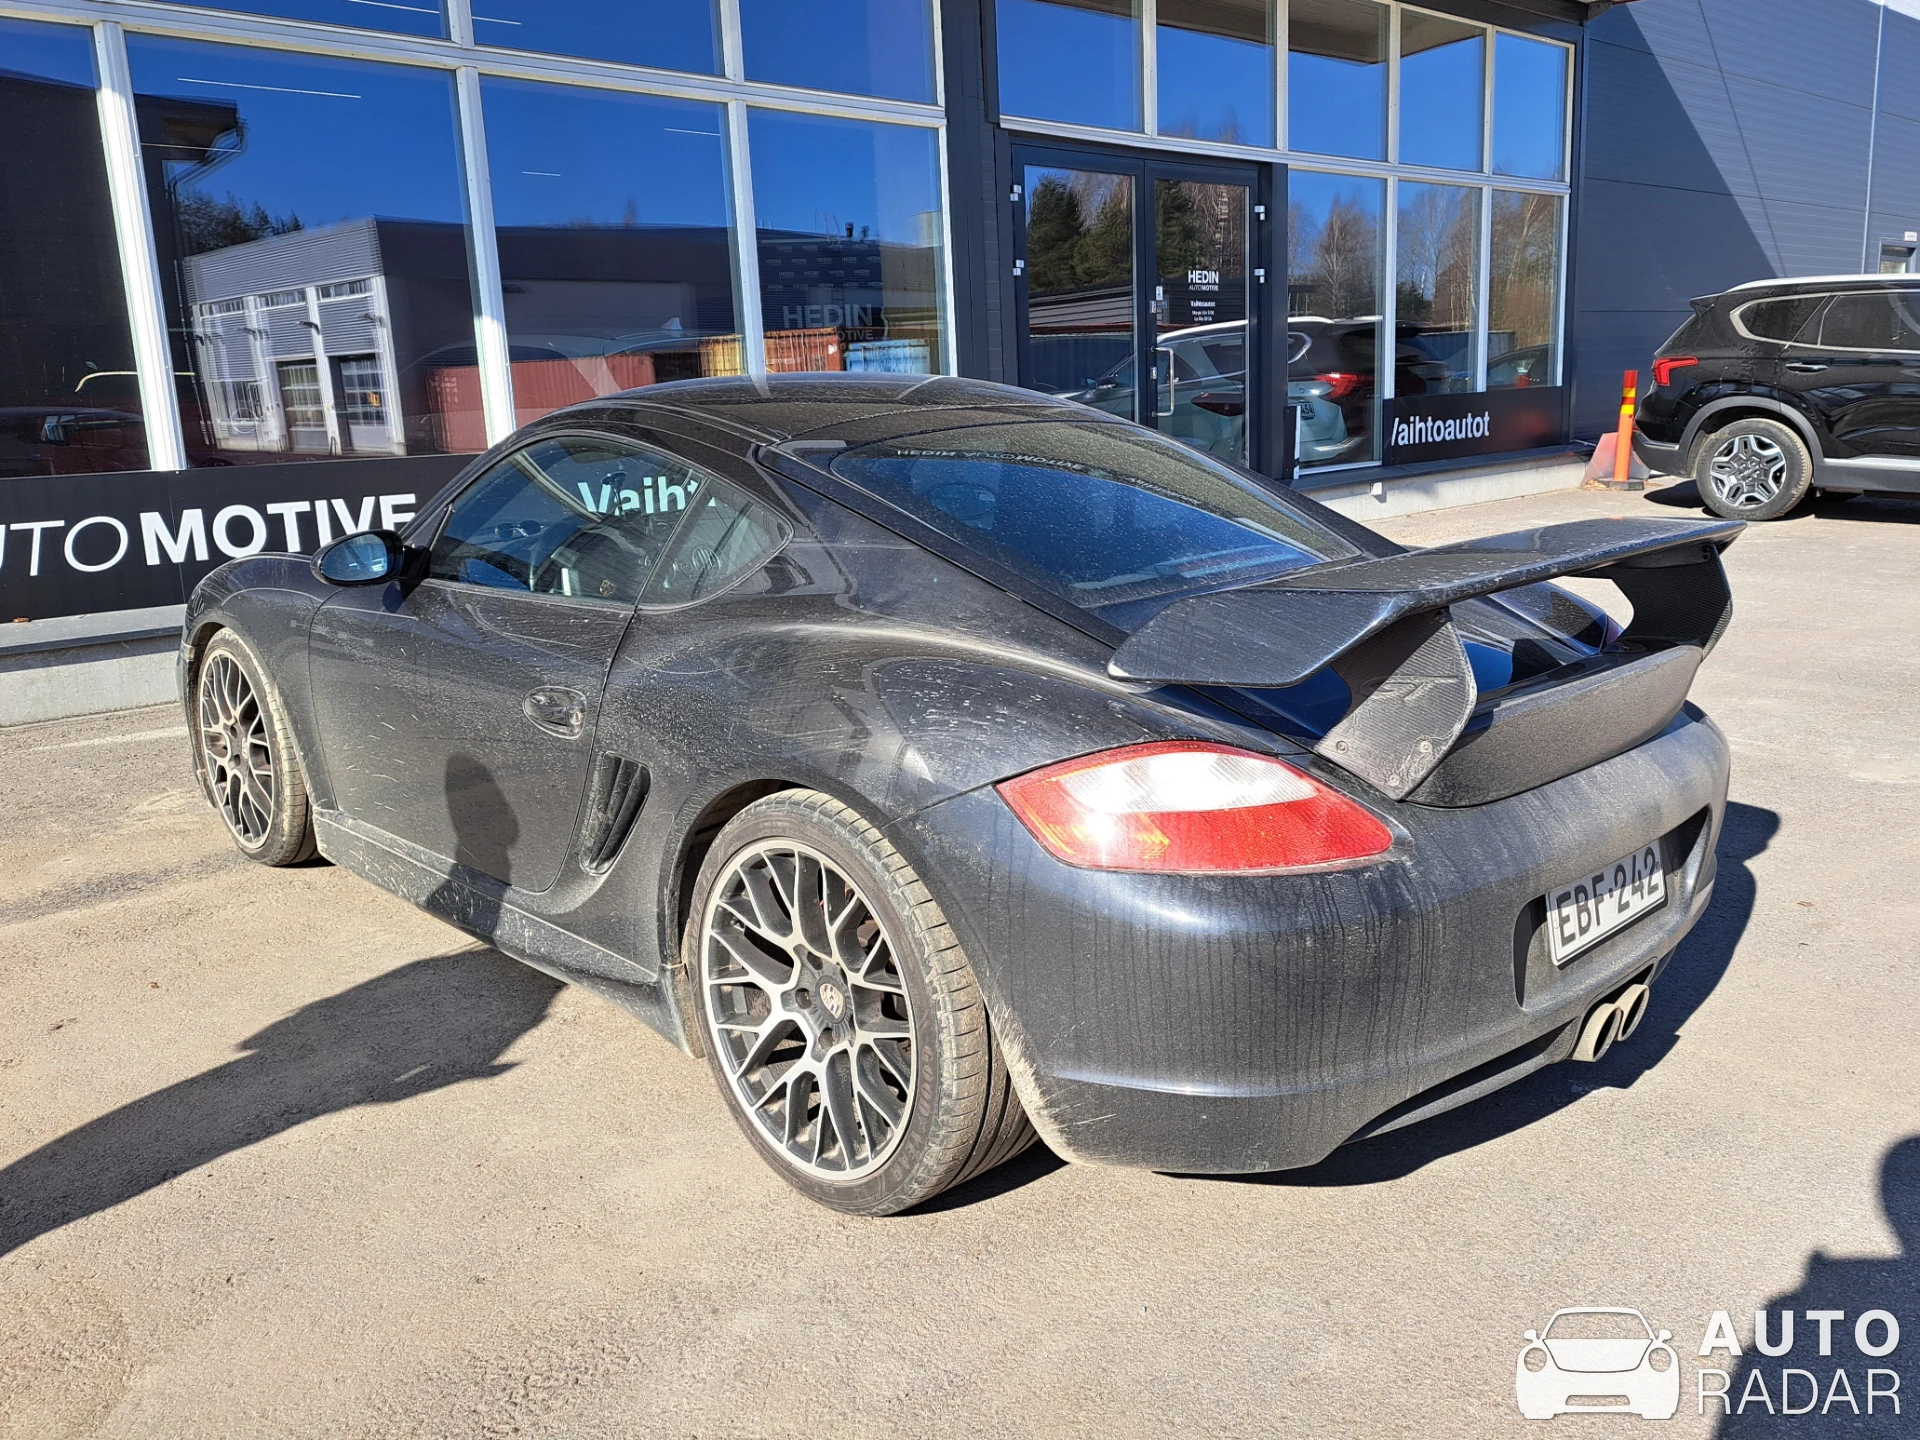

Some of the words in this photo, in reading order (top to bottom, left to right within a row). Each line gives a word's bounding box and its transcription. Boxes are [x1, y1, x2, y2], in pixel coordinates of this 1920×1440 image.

[1188, 270, 1219, 284] HEDIN
[783, 303, 873, 328] HEDIN
[1556, 846, 1659, 948] EBF-242
